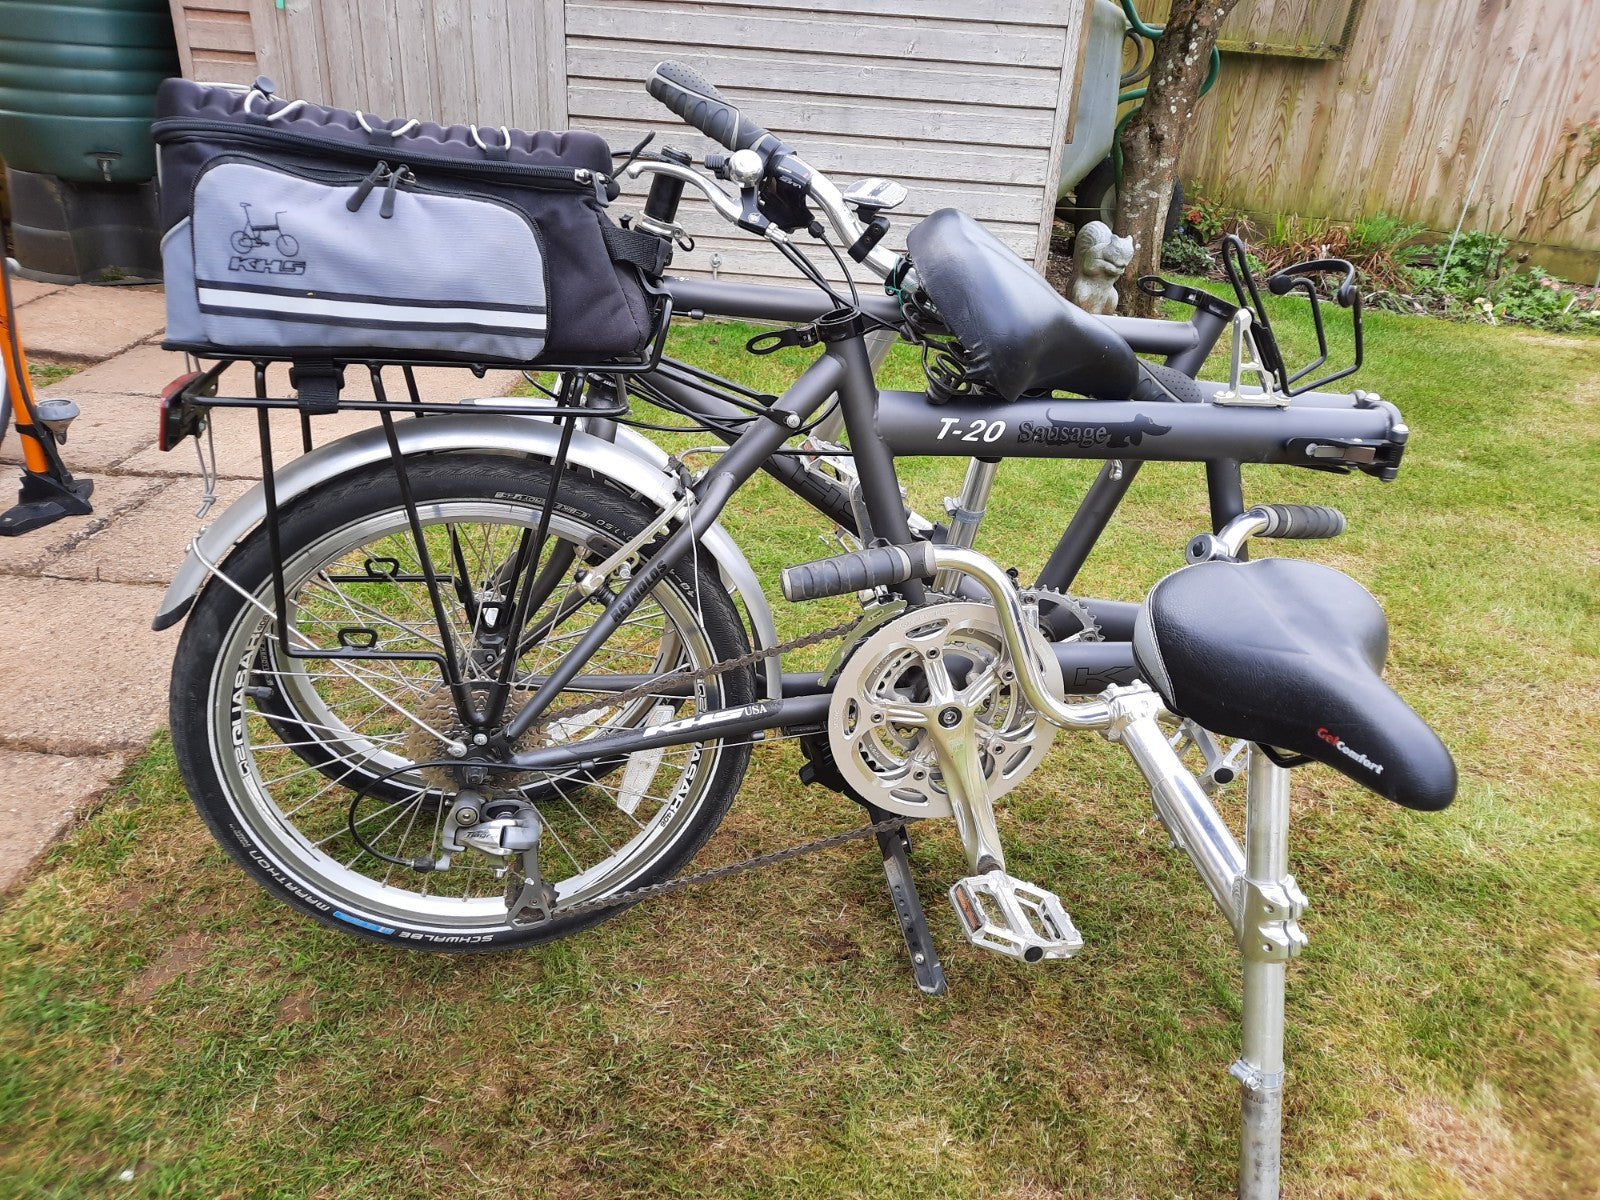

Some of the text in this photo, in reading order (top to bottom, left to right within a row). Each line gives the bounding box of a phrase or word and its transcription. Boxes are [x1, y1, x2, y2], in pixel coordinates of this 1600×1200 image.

[228, 256, 306, 275] KHS
[936, 417, 1007, 443] T-20
[1018, 420, 1108, 448] Sausage
[610, 559, 668, 623] REYNOLDS
[231, 633, 260, 745] QUASAR
[643, 706, 768, 737] KHS USA
[249, 850, 494, 944] SCHWALBE MARATHON
